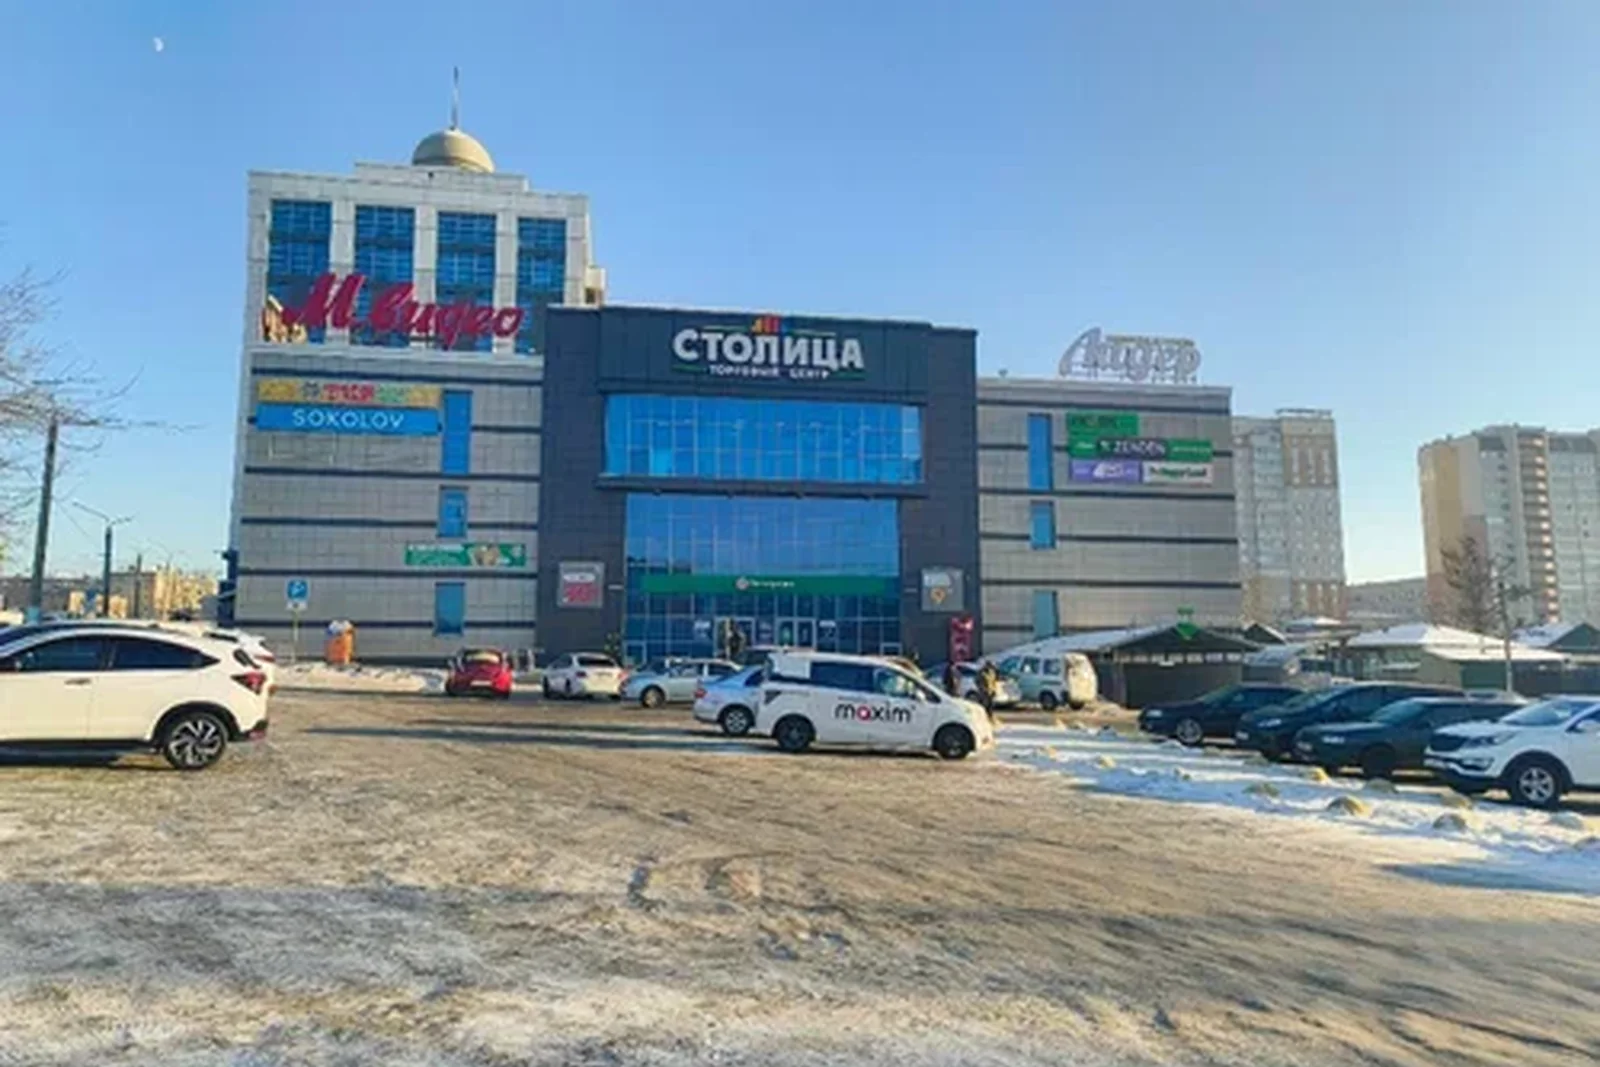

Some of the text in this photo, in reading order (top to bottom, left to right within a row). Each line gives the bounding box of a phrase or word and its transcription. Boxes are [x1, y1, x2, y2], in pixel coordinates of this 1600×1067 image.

[673, 329, 865, 372] СТОЛИЦА
[292, 408, 405, 429] SOKOLOV
[835, 701, 911, 723] maxim
